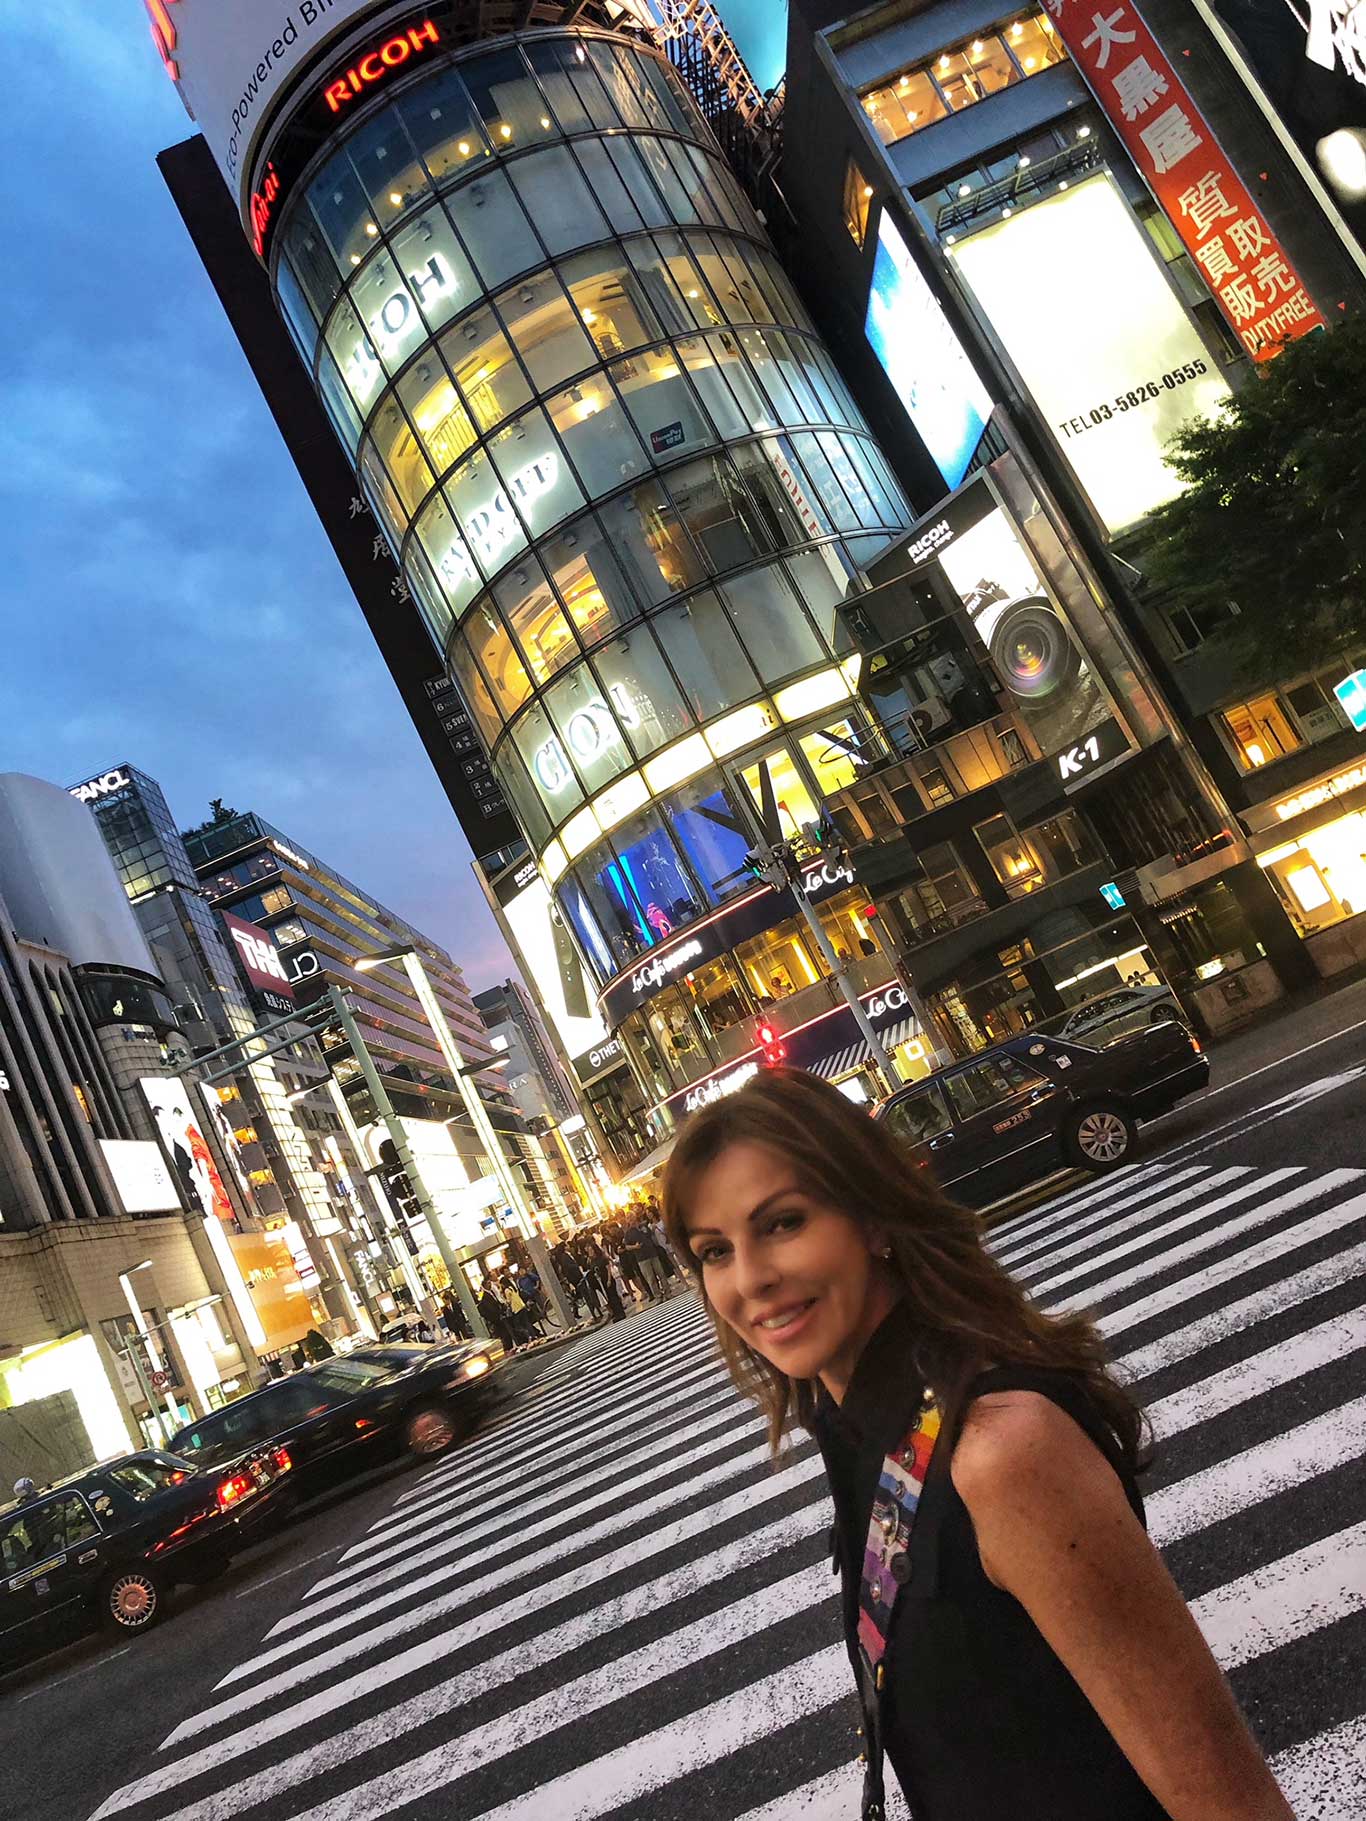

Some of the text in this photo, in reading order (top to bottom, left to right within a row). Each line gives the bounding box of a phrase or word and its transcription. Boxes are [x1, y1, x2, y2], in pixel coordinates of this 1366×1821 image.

[324, 19, 441, 114] RICOH
[1081, 9, 1203, 174] 大黒屋
[1178, 171, 1238, 241] 質
[1240, 288, 1315, 356] DUTYFREE
[907, 519, 950, 558] RICOH
[436, 703, 444, 712] 6
[1058, 736, 1101, 779] K-1
[69, 770, 130, 803] FANCL
[598, 1040, 621, 1059] THET
